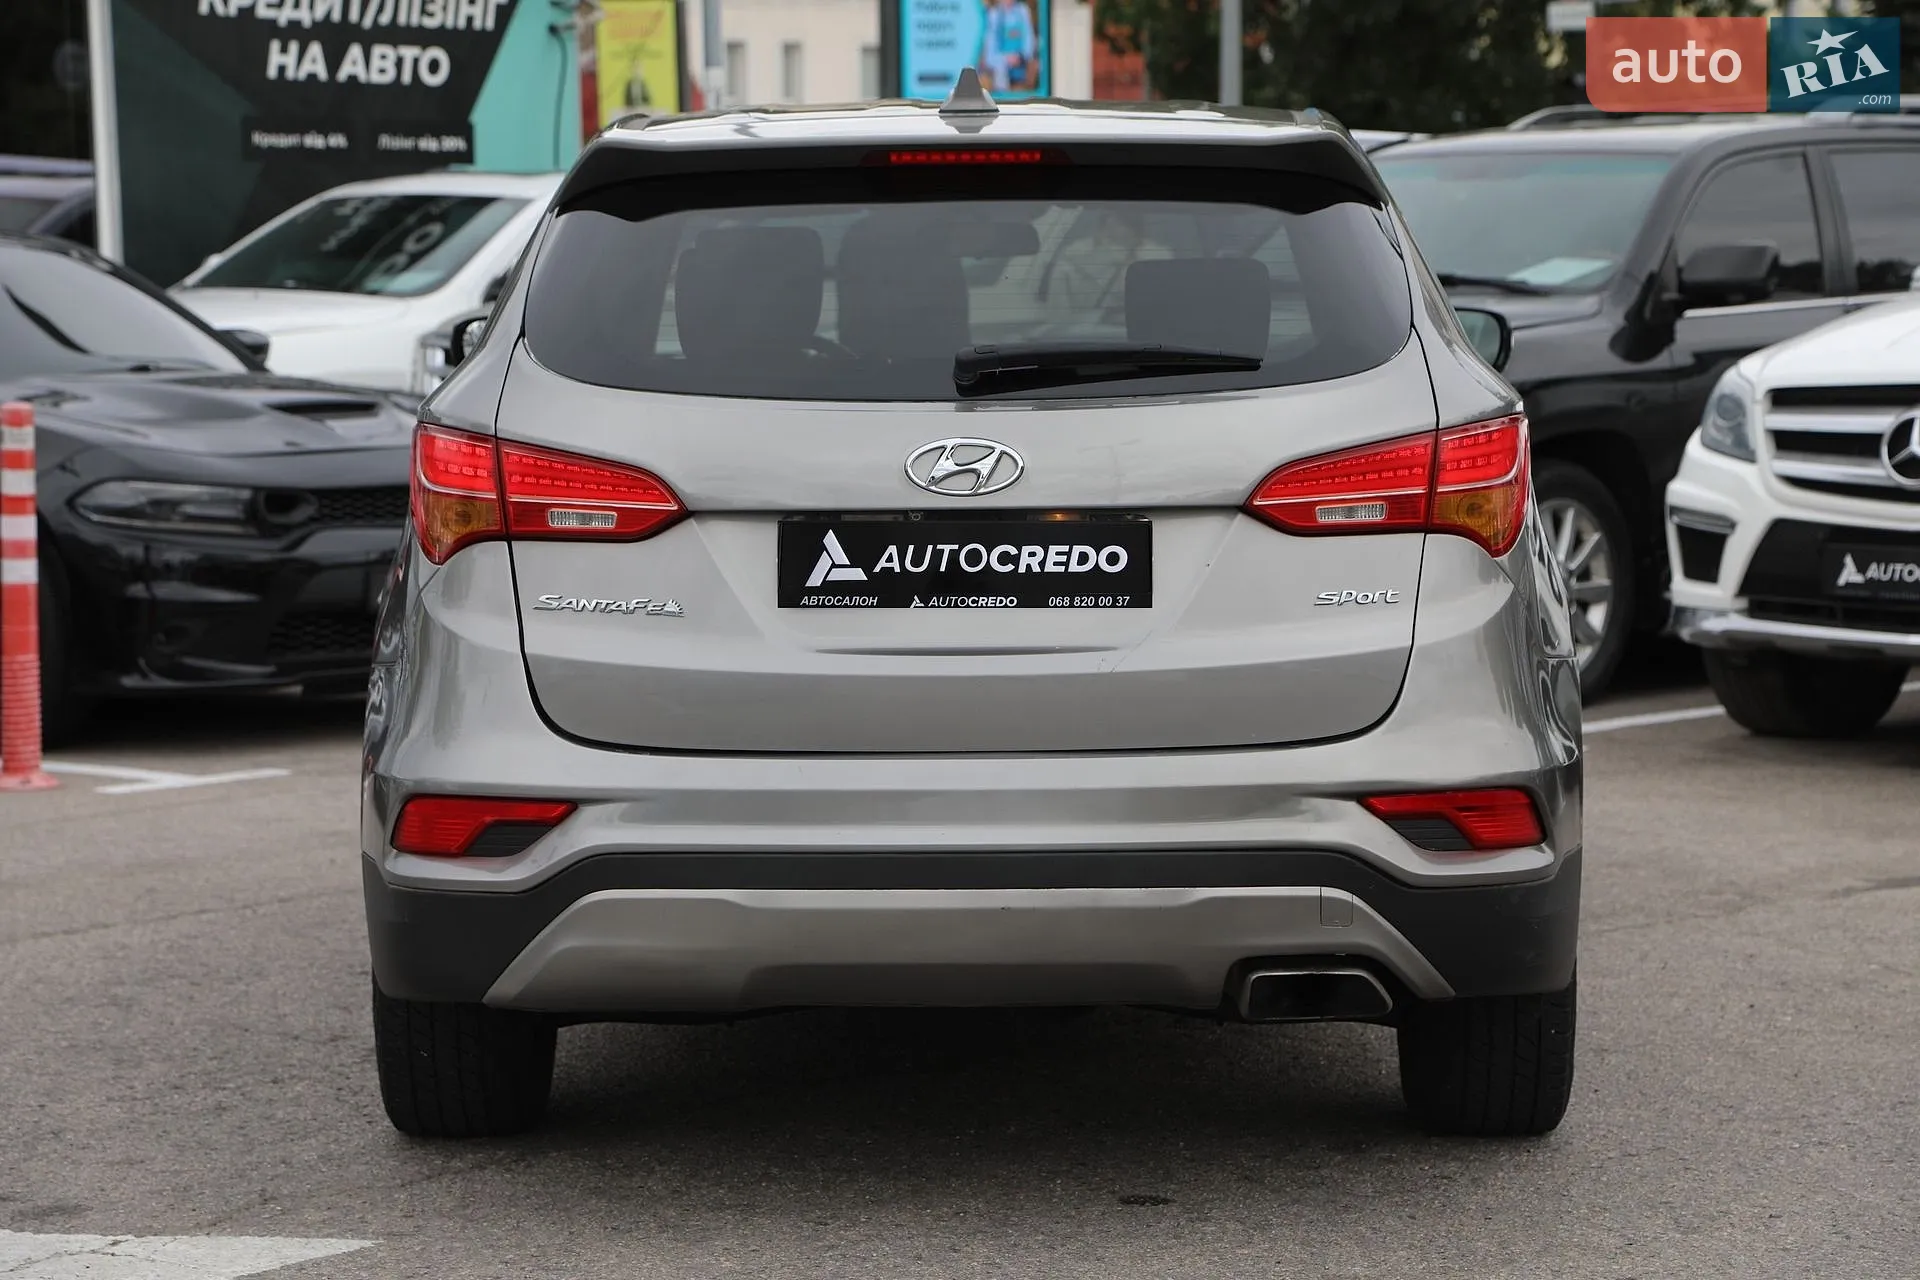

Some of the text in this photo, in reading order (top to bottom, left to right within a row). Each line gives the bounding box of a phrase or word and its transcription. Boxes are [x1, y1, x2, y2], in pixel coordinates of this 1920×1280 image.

[266, 38, 451, 88] НА АВТО
[873, 543, 1128, 573] AUTOCREDO
[1864, 561, 1920, 583] AUTO
[800, 595, 878, 607] АВТОСАЛОН
[928, 596, 1018, 608] AUTOCREDO
[1048, 595, 1131, 608] 068 820 00 37
